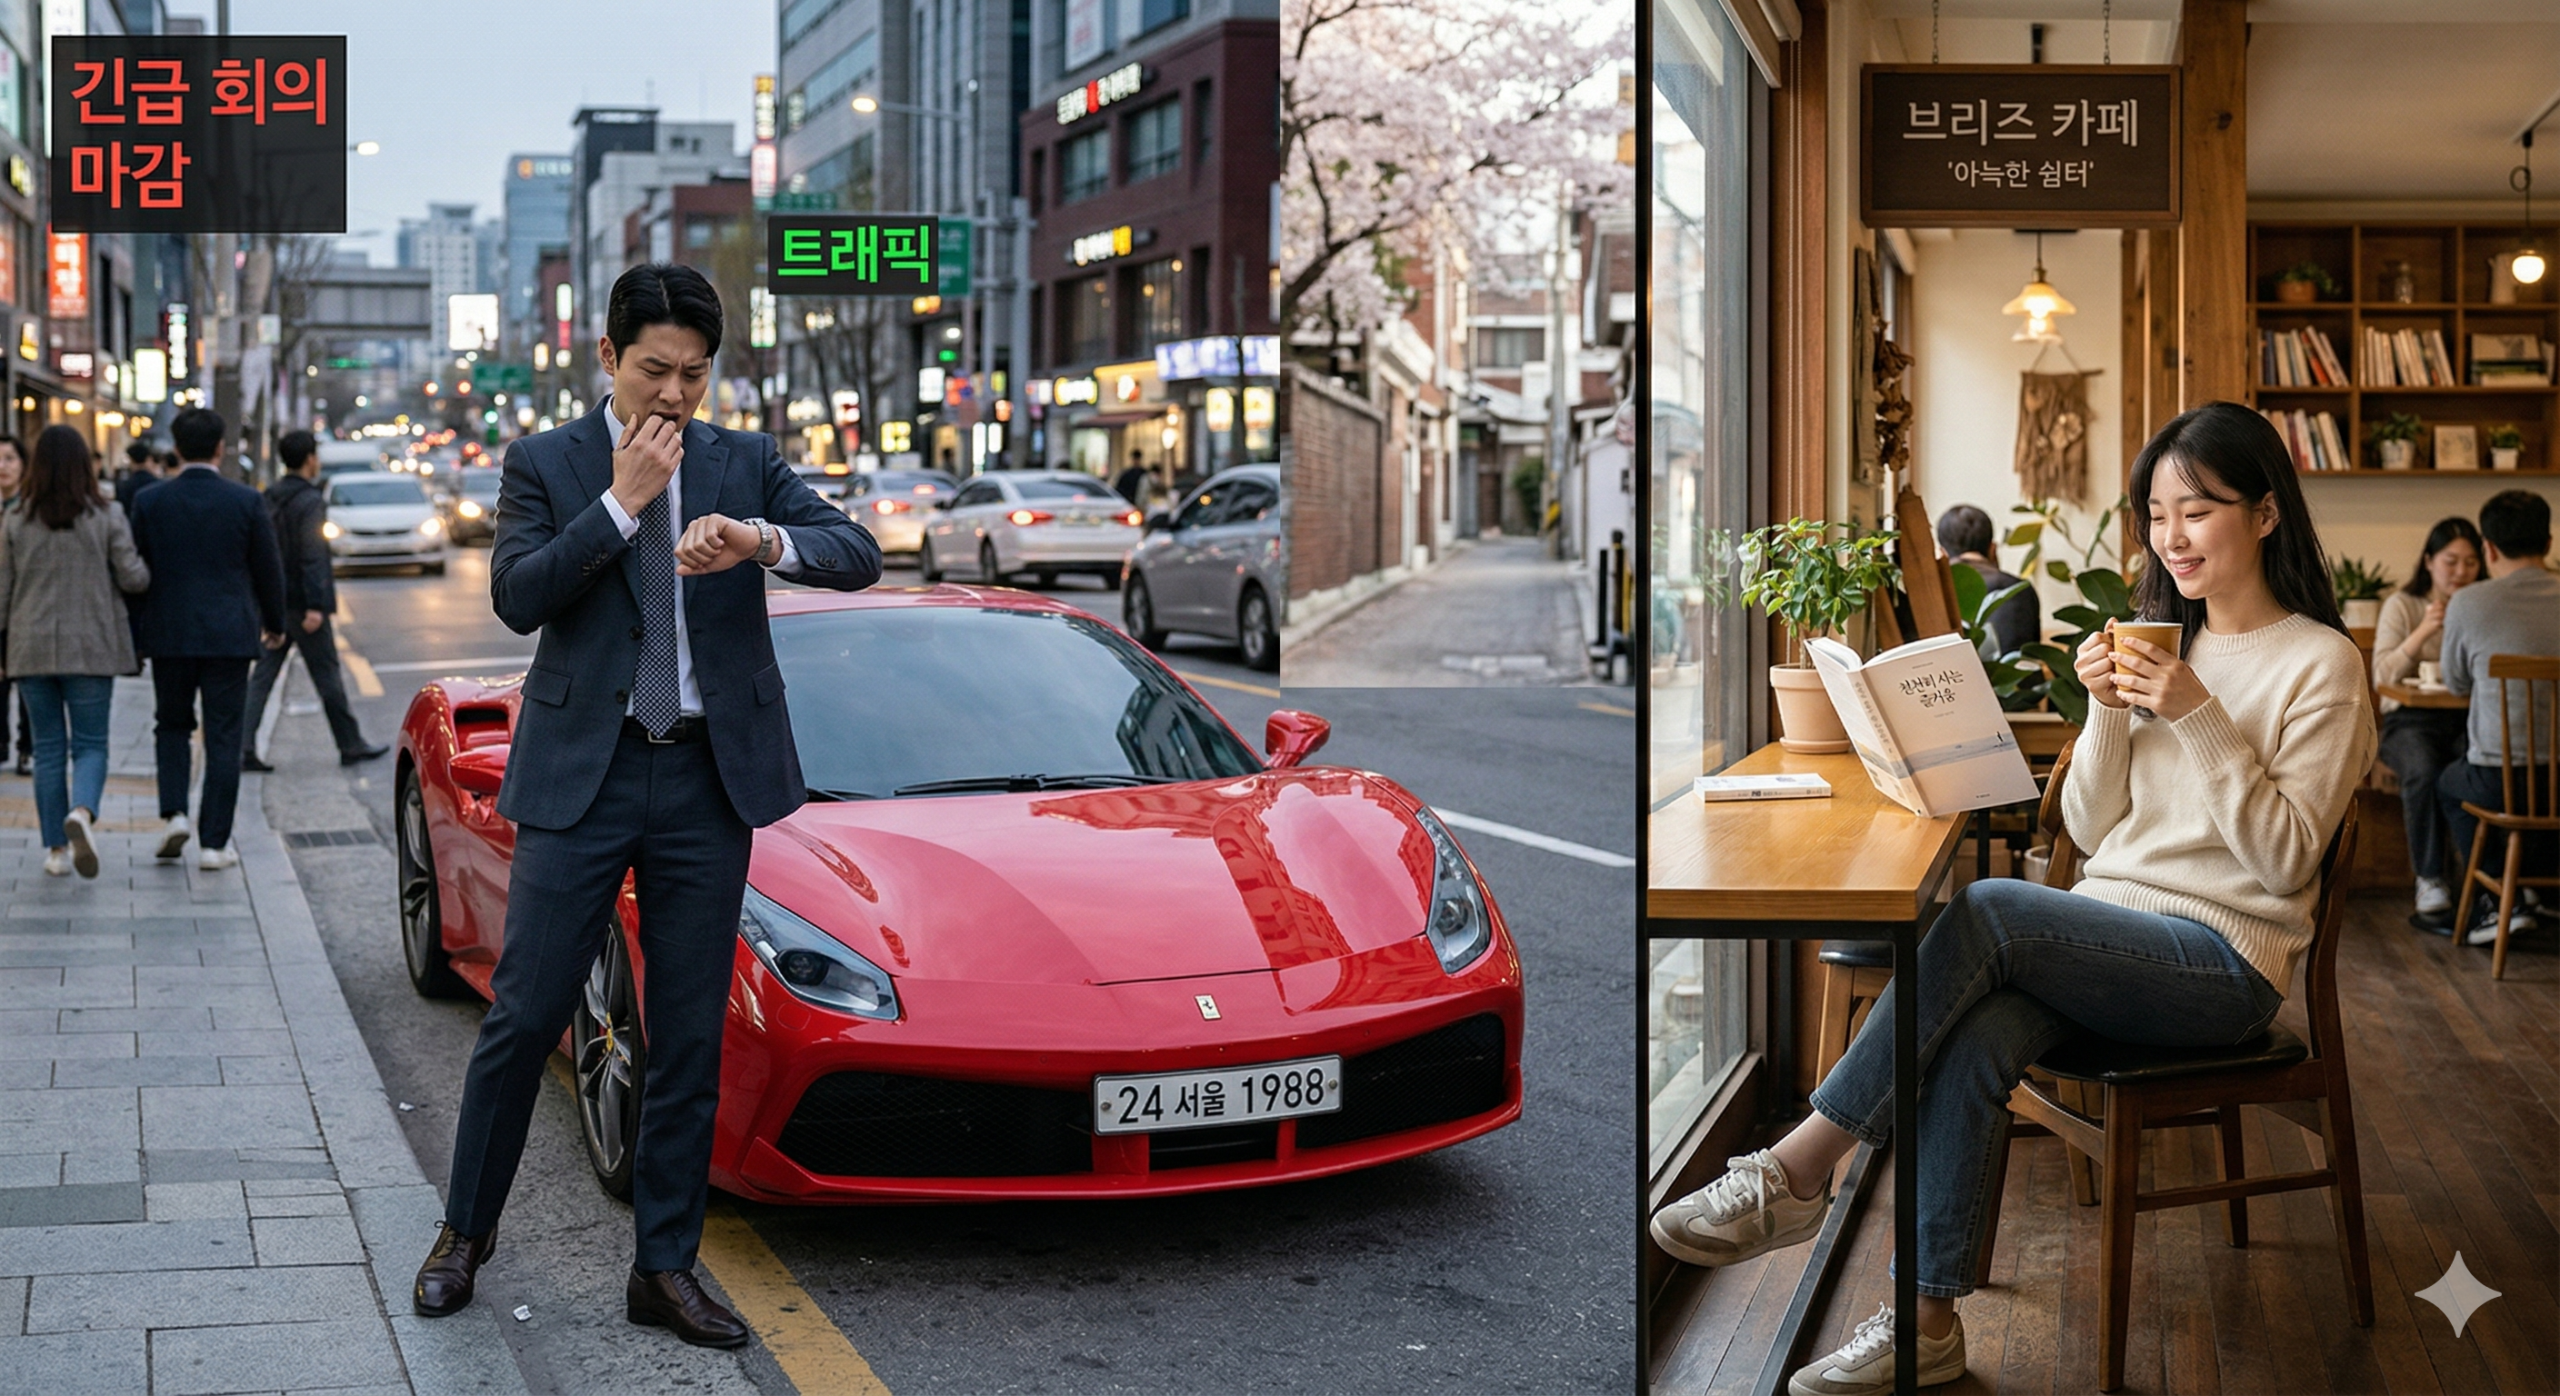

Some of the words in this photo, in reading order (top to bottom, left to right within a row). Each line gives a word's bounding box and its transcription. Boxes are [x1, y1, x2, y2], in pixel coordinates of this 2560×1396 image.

[1903, 98, 2037, 146] 브리즈
[2052, 98, 2138, 146] 카페
[1948, 160, 2030, 188] '아늑한
[2038, 160, 2094, 188] 쉼터'
[1118, 1084, 1164, 1125] 24
[1174, 1080, 1226, 1118] 서울
[1241, 1067, 1325, 1114] 1988
